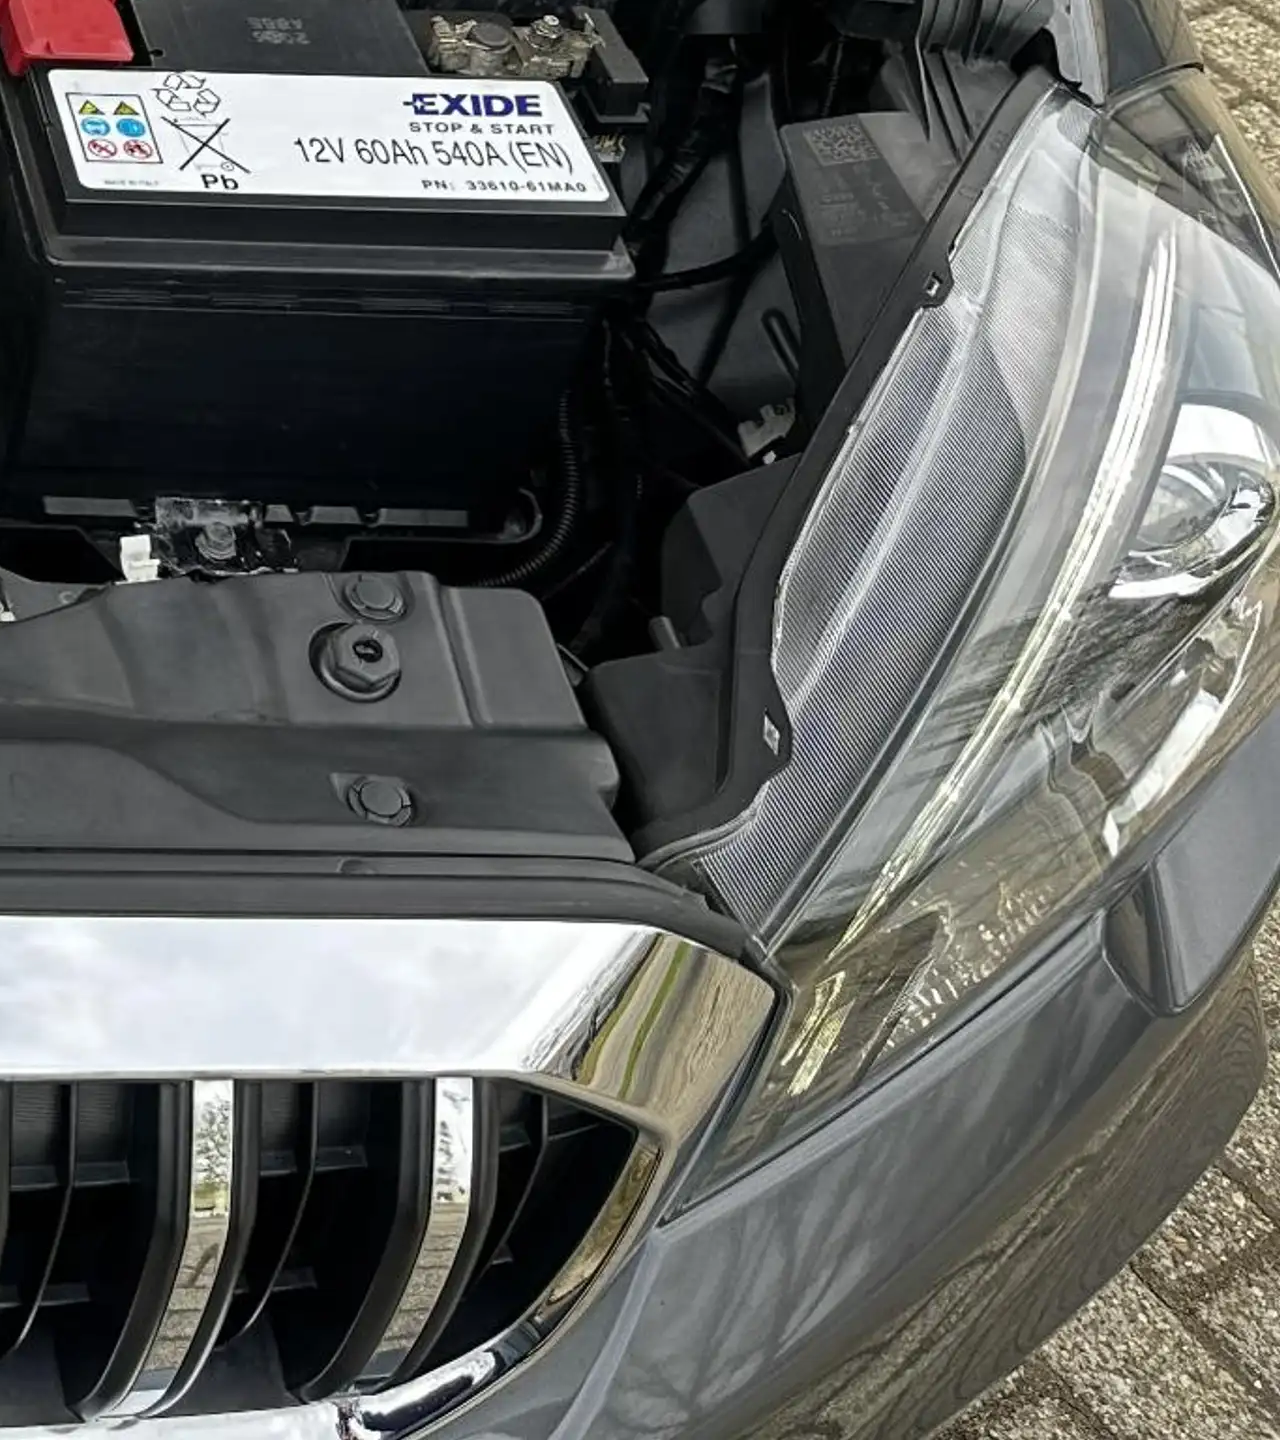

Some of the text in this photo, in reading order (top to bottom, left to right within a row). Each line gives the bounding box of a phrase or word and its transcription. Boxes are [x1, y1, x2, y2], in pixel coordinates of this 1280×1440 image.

[403, 92, 543, 117] EXIDE
[409, 121, 555, 136] STOP & START
[294, 137, 345, 163] 12V
[354, 138, 426, 166] 60Ah
[200, 173, 239, 191] Pb
